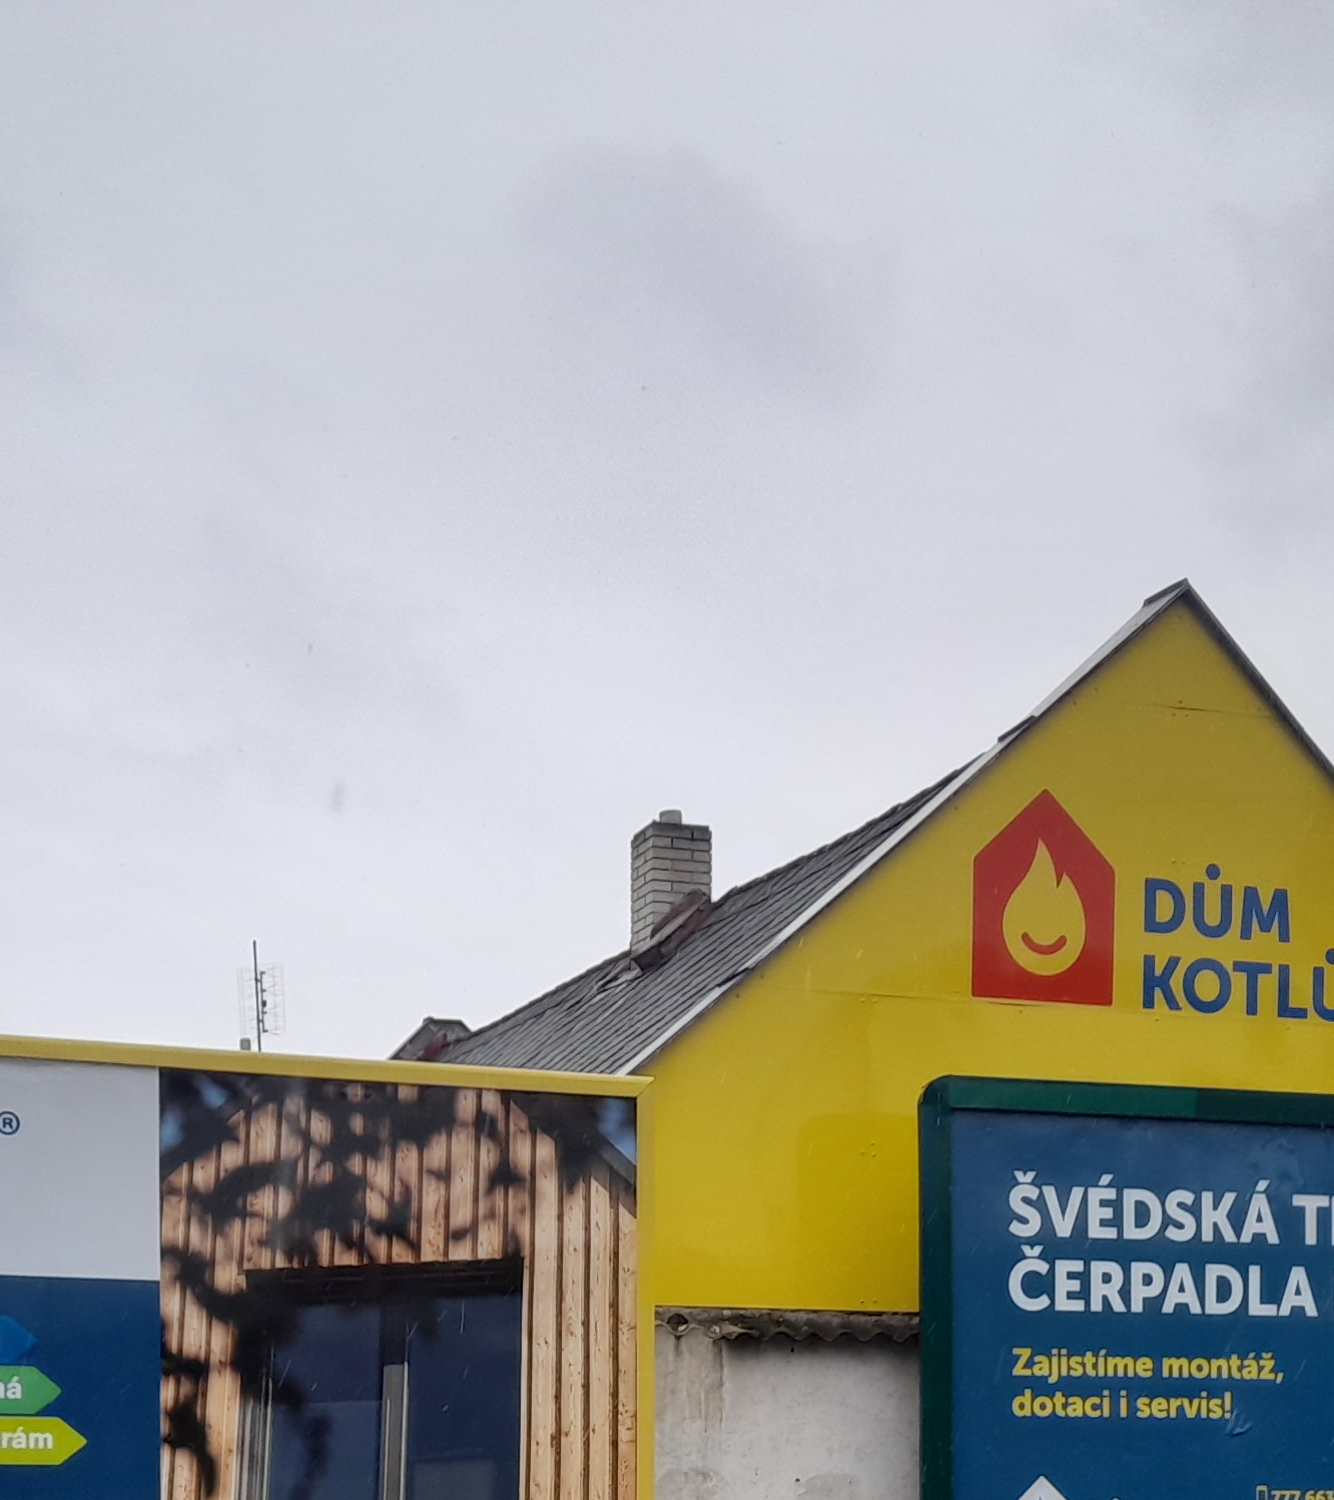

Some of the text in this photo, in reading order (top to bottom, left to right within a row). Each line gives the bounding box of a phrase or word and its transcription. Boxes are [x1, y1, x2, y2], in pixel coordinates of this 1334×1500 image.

[1143, 863, 1291, 944] DŮM
[1008, 1170, 1274, 1247] ŠVÉDSKÁ
[1008, 1244, 1319, 1317] ČERPADLA
[1011, 1347, 1284, 1384] Zajistíme montáž,
[1011, 1388, 1233, 1421] dotaci i servis!
